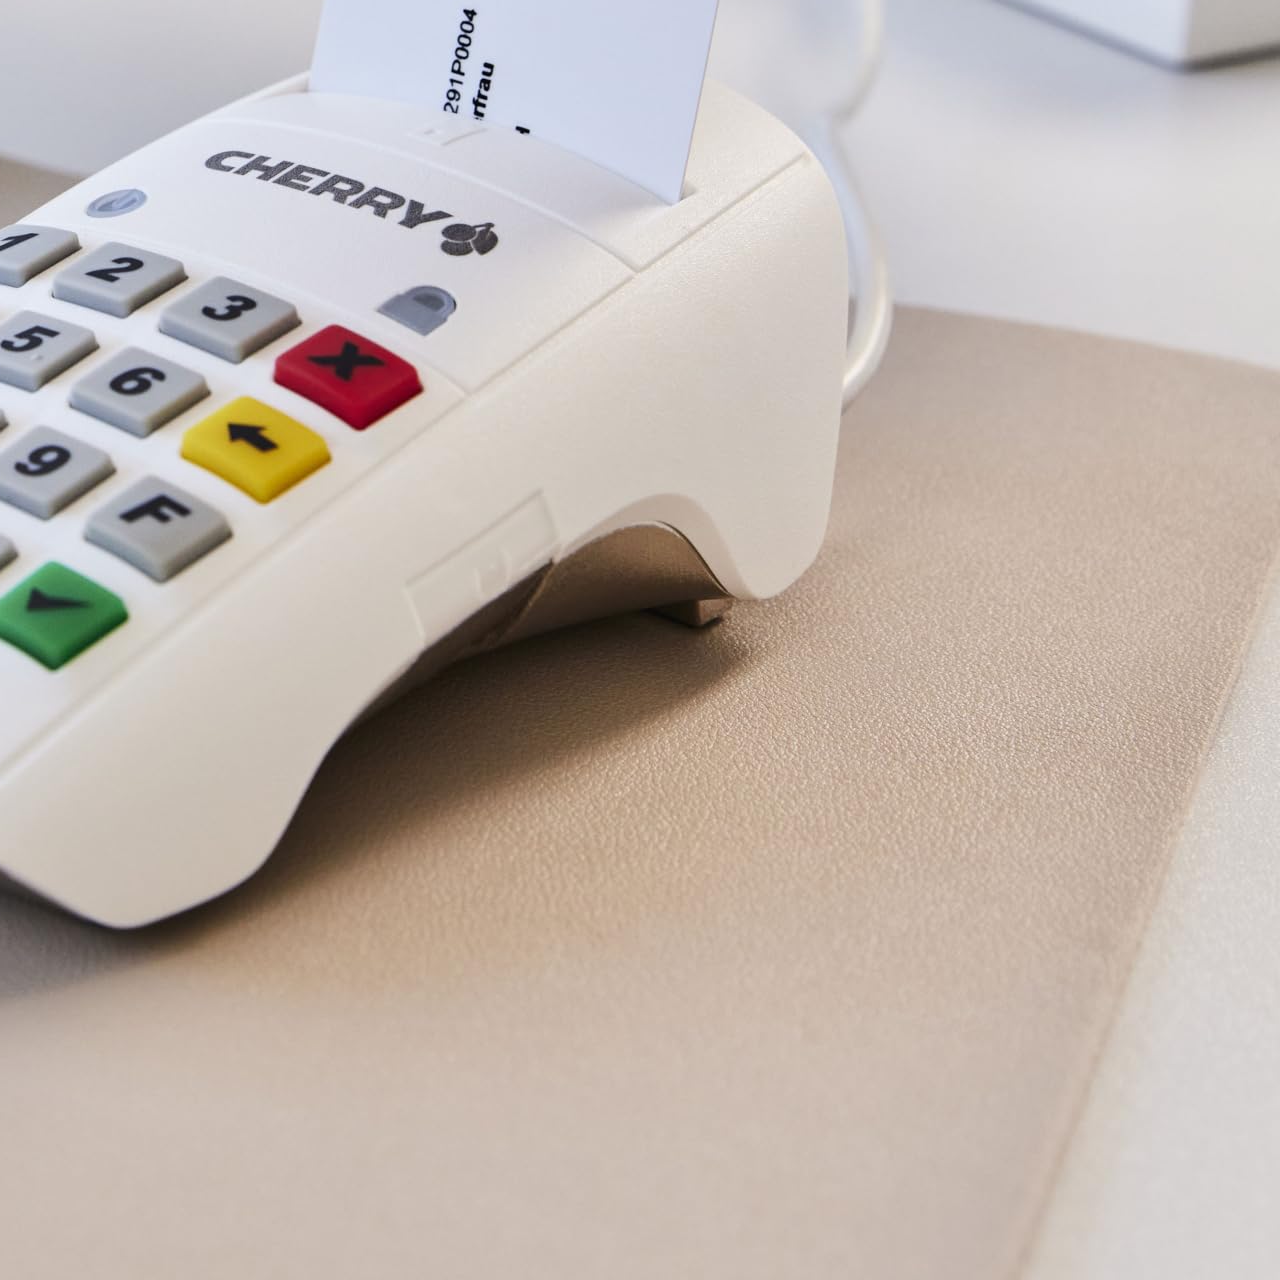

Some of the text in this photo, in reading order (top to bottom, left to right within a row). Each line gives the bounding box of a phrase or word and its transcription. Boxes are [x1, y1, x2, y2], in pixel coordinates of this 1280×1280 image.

[443, 8, 477, 114] 291P0004
[473, 62, 495, 121] rfrau
[205, 150, 453, 229] CHERRY
[85, 256, 145, 282] 2
[201, 294, 258, 321] 3
[0, 325, 60, 353] 5
[108, 366, 166, 396] 6
[14, 444, 72, 477] 9
[119, 494, 192, 526] F
